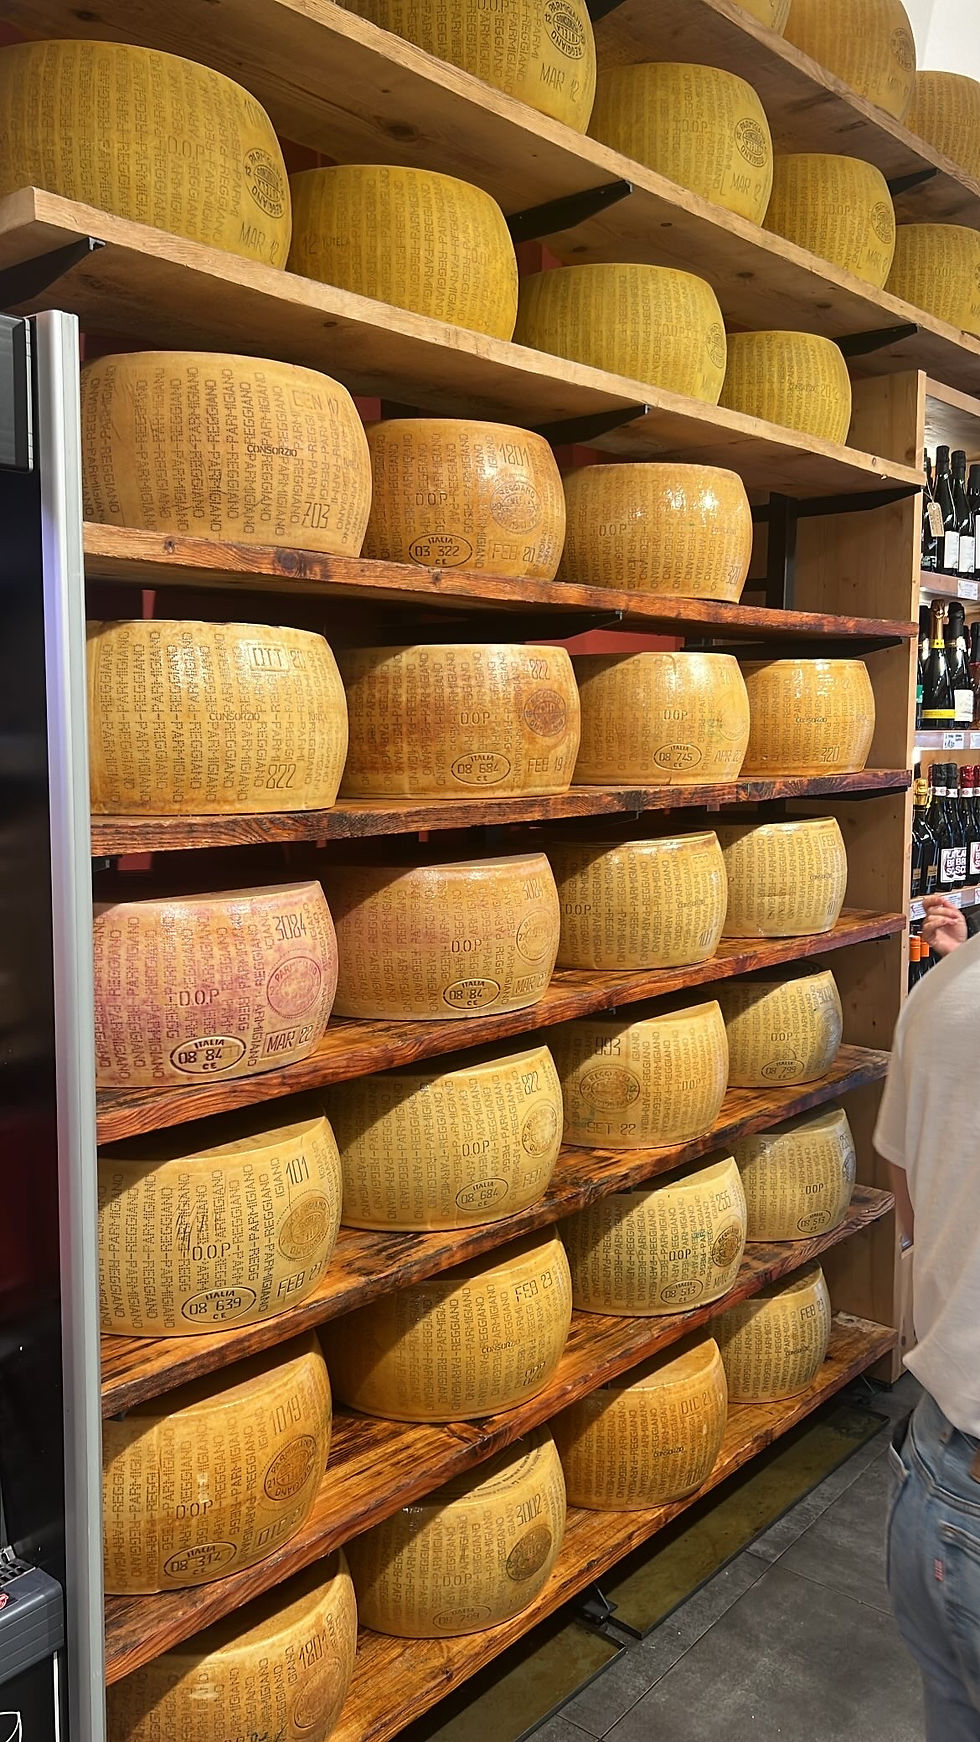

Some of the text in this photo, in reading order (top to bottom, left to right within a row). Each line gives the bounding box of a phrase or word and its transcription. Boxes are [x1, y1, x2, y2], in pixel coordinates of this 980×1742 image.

[540, 64, 565, 90] MAR
[240, 222, 266, 254] MAR
[247, 443, 298, 458] CONSORZIO
[303, 501, 330, 528] 703
[428, 536, 454, 545] ITALIA
[415, 545, 460, 557] 03 322
[492, 544, 518, 561] FEB
[208, 711, 261, 722] CONSORZIO
[470, 755, 495, 763] ITALIA
[527, 757, 549, 772] FEB
[266, 763, 297, 790] 822
[457, 764, 472, 774] 08
[273, 913, 306, 941] 3084
[461, 980, 485, 988] ITALIA
[450, 990, 463, 999] 08
[193, 1038, 225, 1049] ITALIA
[266, 1025, 314, 1053] MAR 22
[179, 1048, 223, 1063] 08 84
[521, 1071, 541, 1095] 822
[586, 1121, 636, 1136] SET 22
[285, 1156, 310, 1186] 101
[472, 1181, 494, 1192] ITALIA
[461, 1188, 499, 1205] 08 684
[277, 1272, 305, 1298] FEB
[515, 1271, 553, 1302] FEB 23
[206, 1290, 235, 1299] ITALIA
[190, 1298, 242, 1315] 08 639
[801, 1304, 816, 1320] FEB
[680, 1397, 698, 1414] DIC
[515, 1493, 542, 1527] 3002
[170, 1561, 188, 1572] 08
